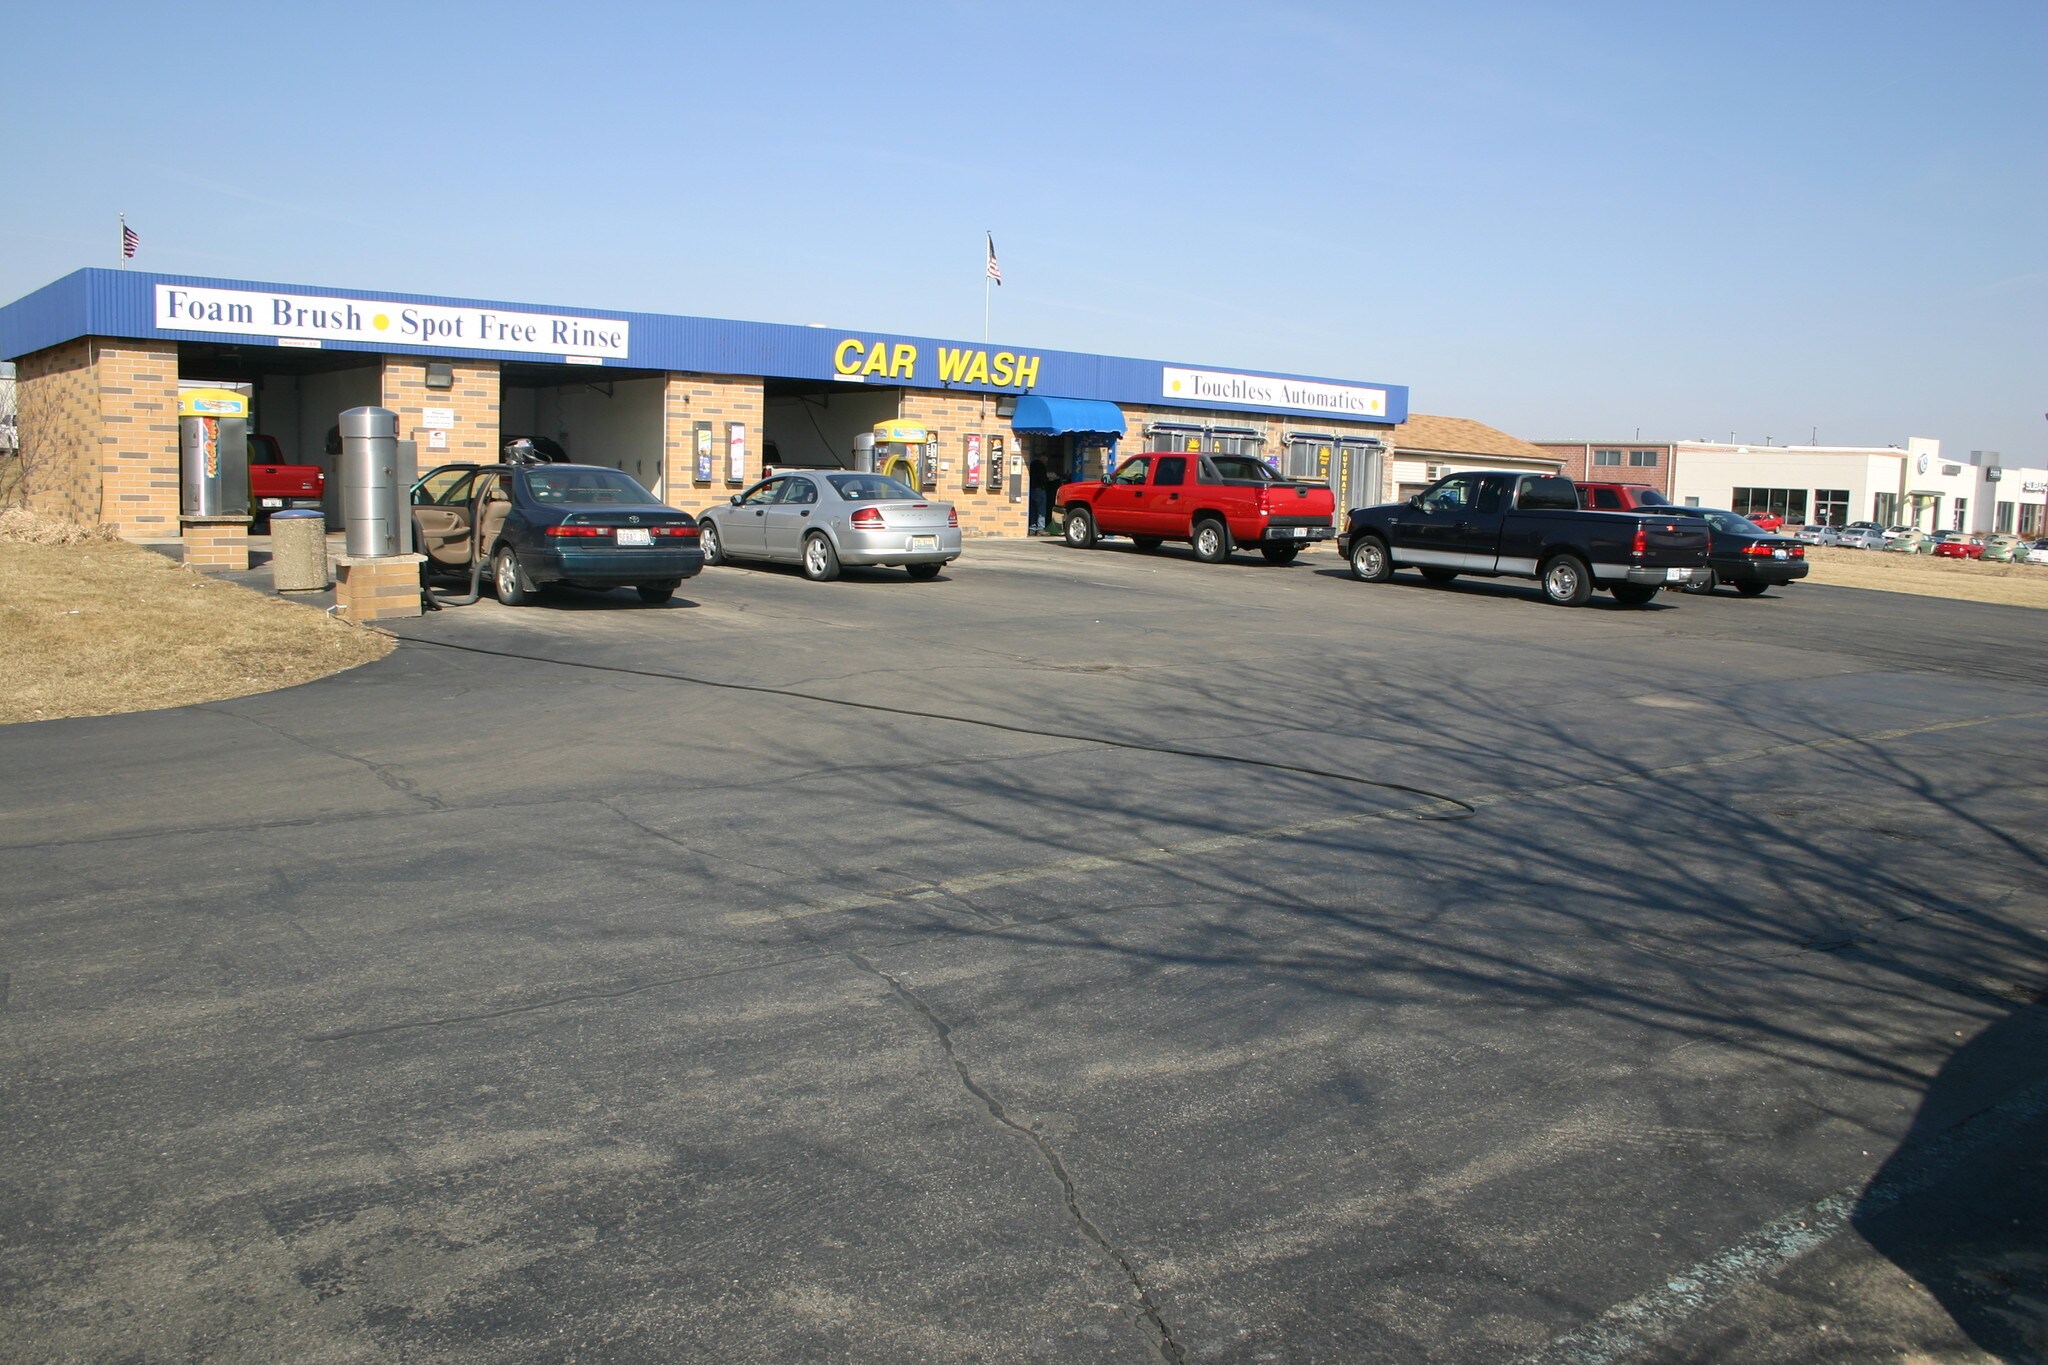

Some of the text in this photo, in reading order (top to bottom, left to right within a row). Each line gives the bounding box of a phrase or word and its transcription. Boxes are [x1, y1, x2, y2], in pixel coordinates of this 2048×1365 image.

[166, 289, 622, 349] Foam Brush Spot Free Rinse
[834, 338, 1041, 388] CAR WASH
[1191, 375, 1365, 411] Touchless Automatics
[1339, 449, 1348, 531] AUTOMATICALLY
